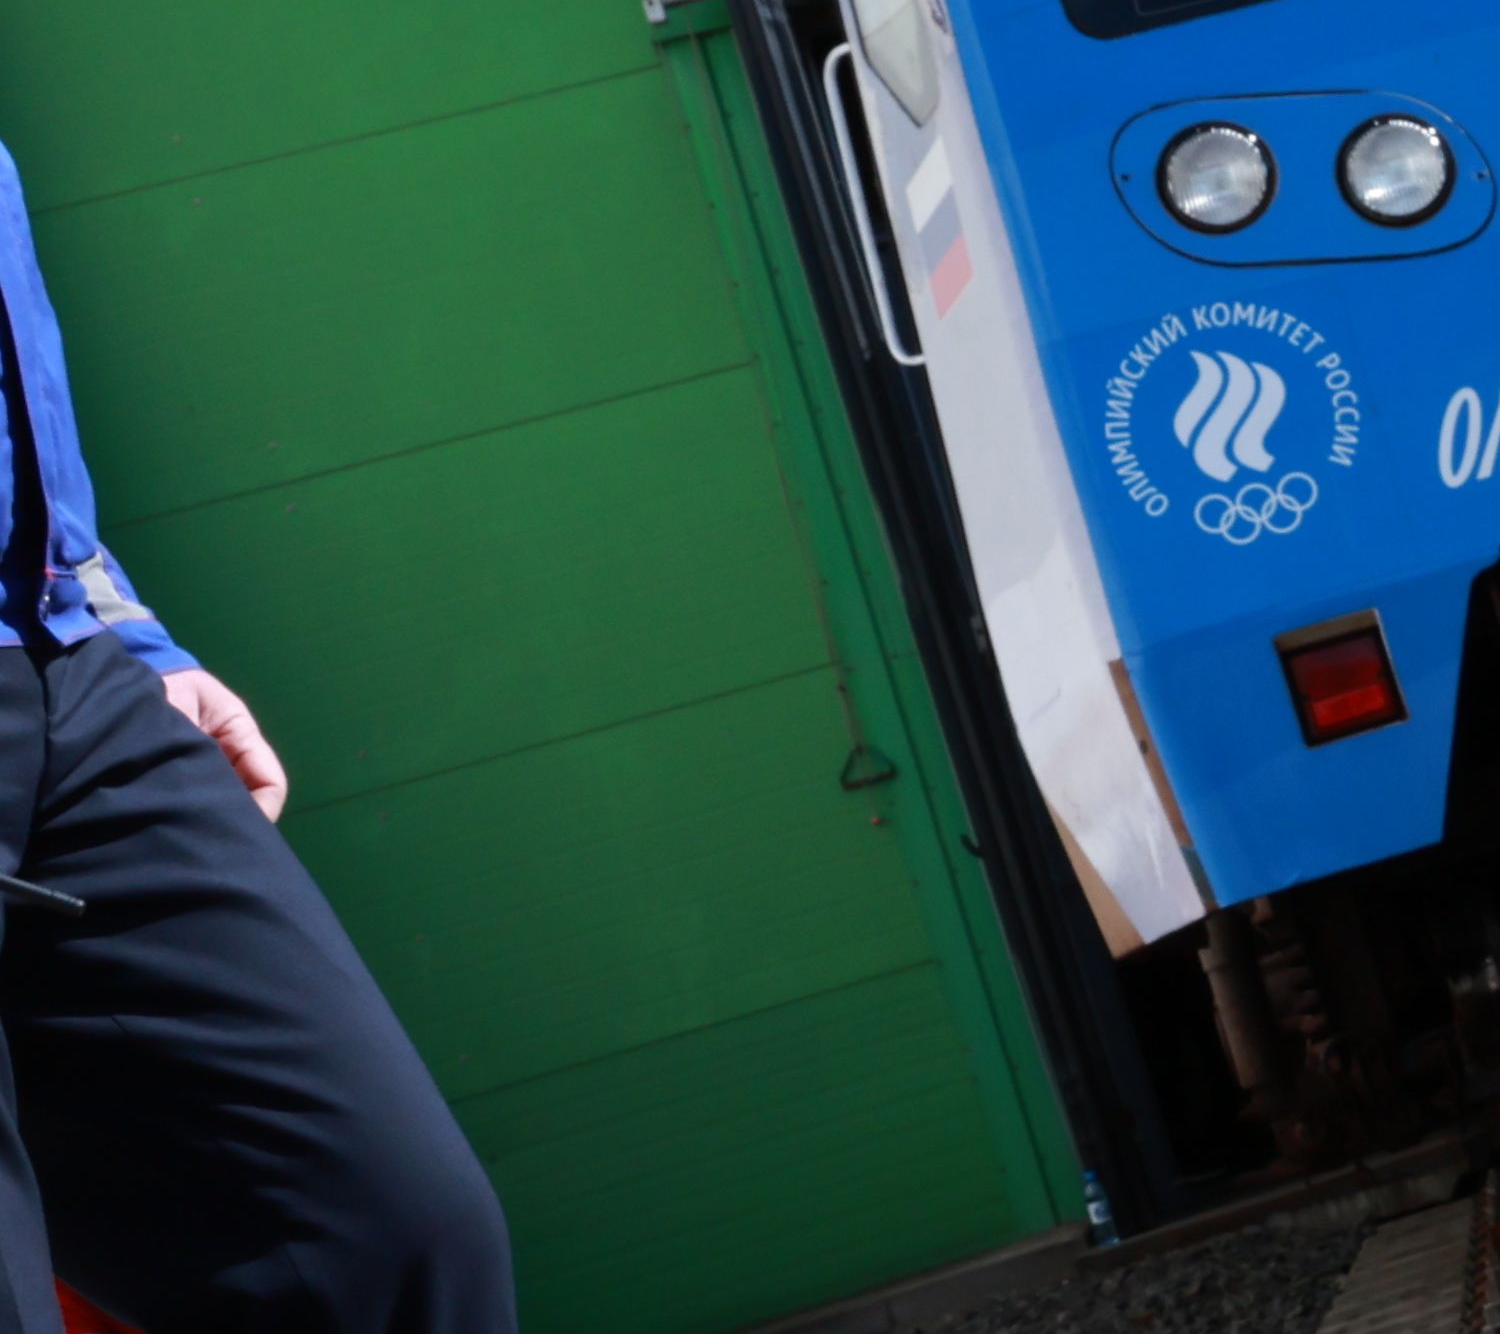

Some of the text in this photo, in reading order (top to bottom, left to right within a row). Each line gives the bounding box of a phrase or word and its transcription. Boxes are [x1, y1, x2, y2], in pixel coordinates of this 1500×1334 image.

[1104, 300, 1361, 518] ОЛИМПИЙСКИЙ КОМИТЕТ РОССИИ
